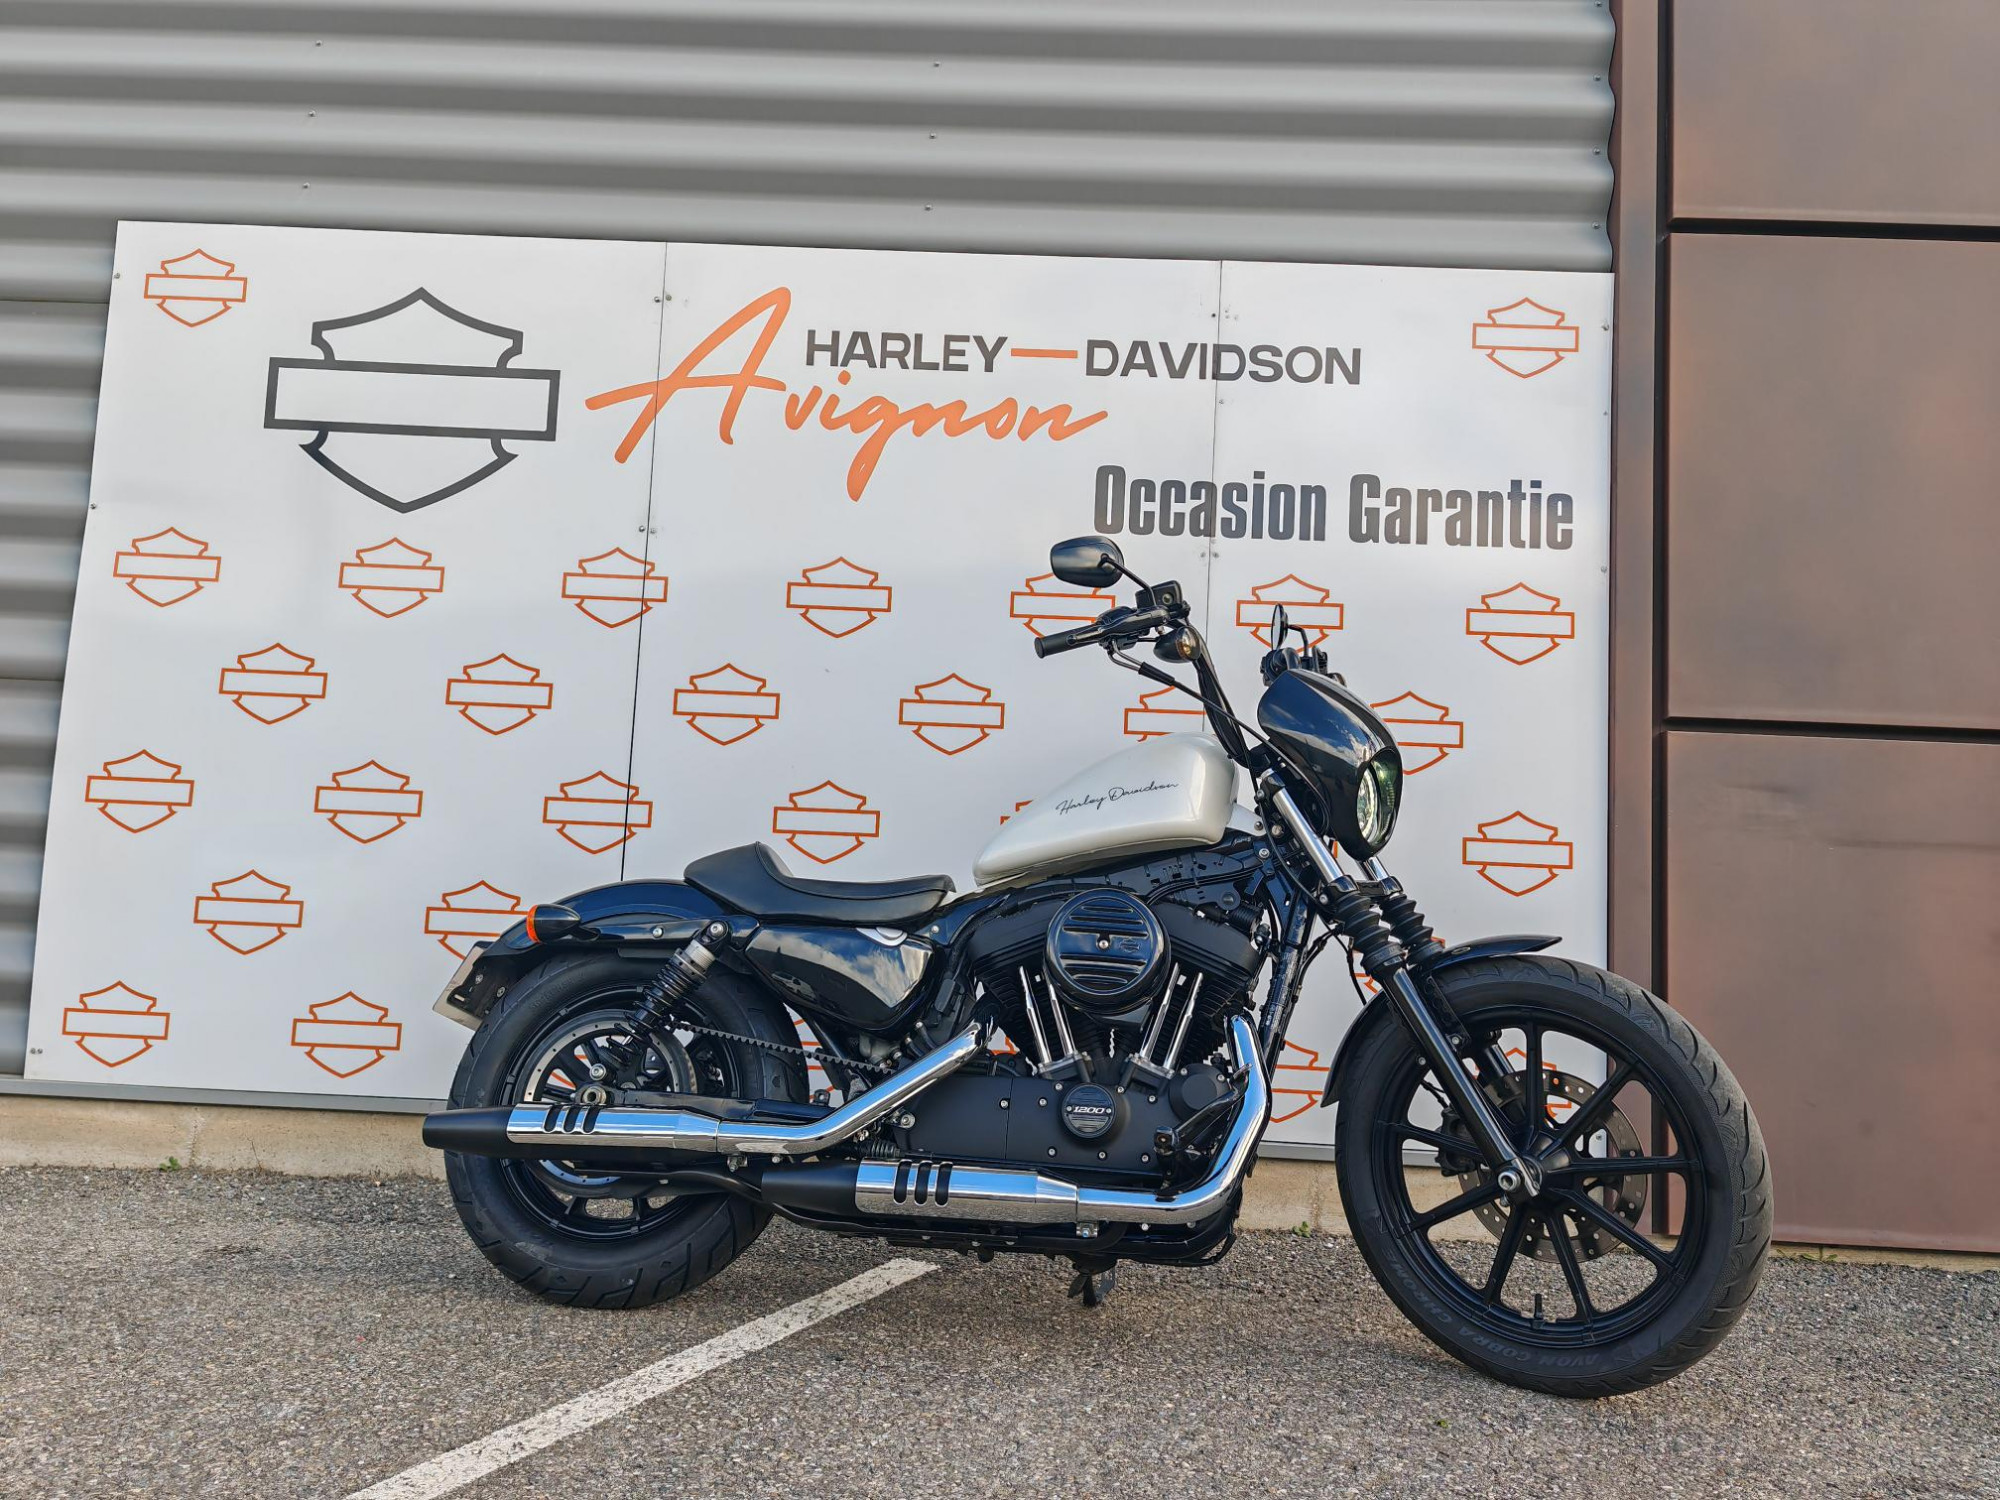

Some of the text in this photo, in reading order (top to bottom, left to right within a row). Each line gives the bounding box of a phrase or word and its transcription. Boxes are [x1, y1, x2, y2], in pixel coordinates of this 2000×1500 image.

[585, 286, 1108, 502] Avignon
[1093, 464, 1573, 551] Occasion Garantie
[1073, 1105, 1106, 1114] 1200
